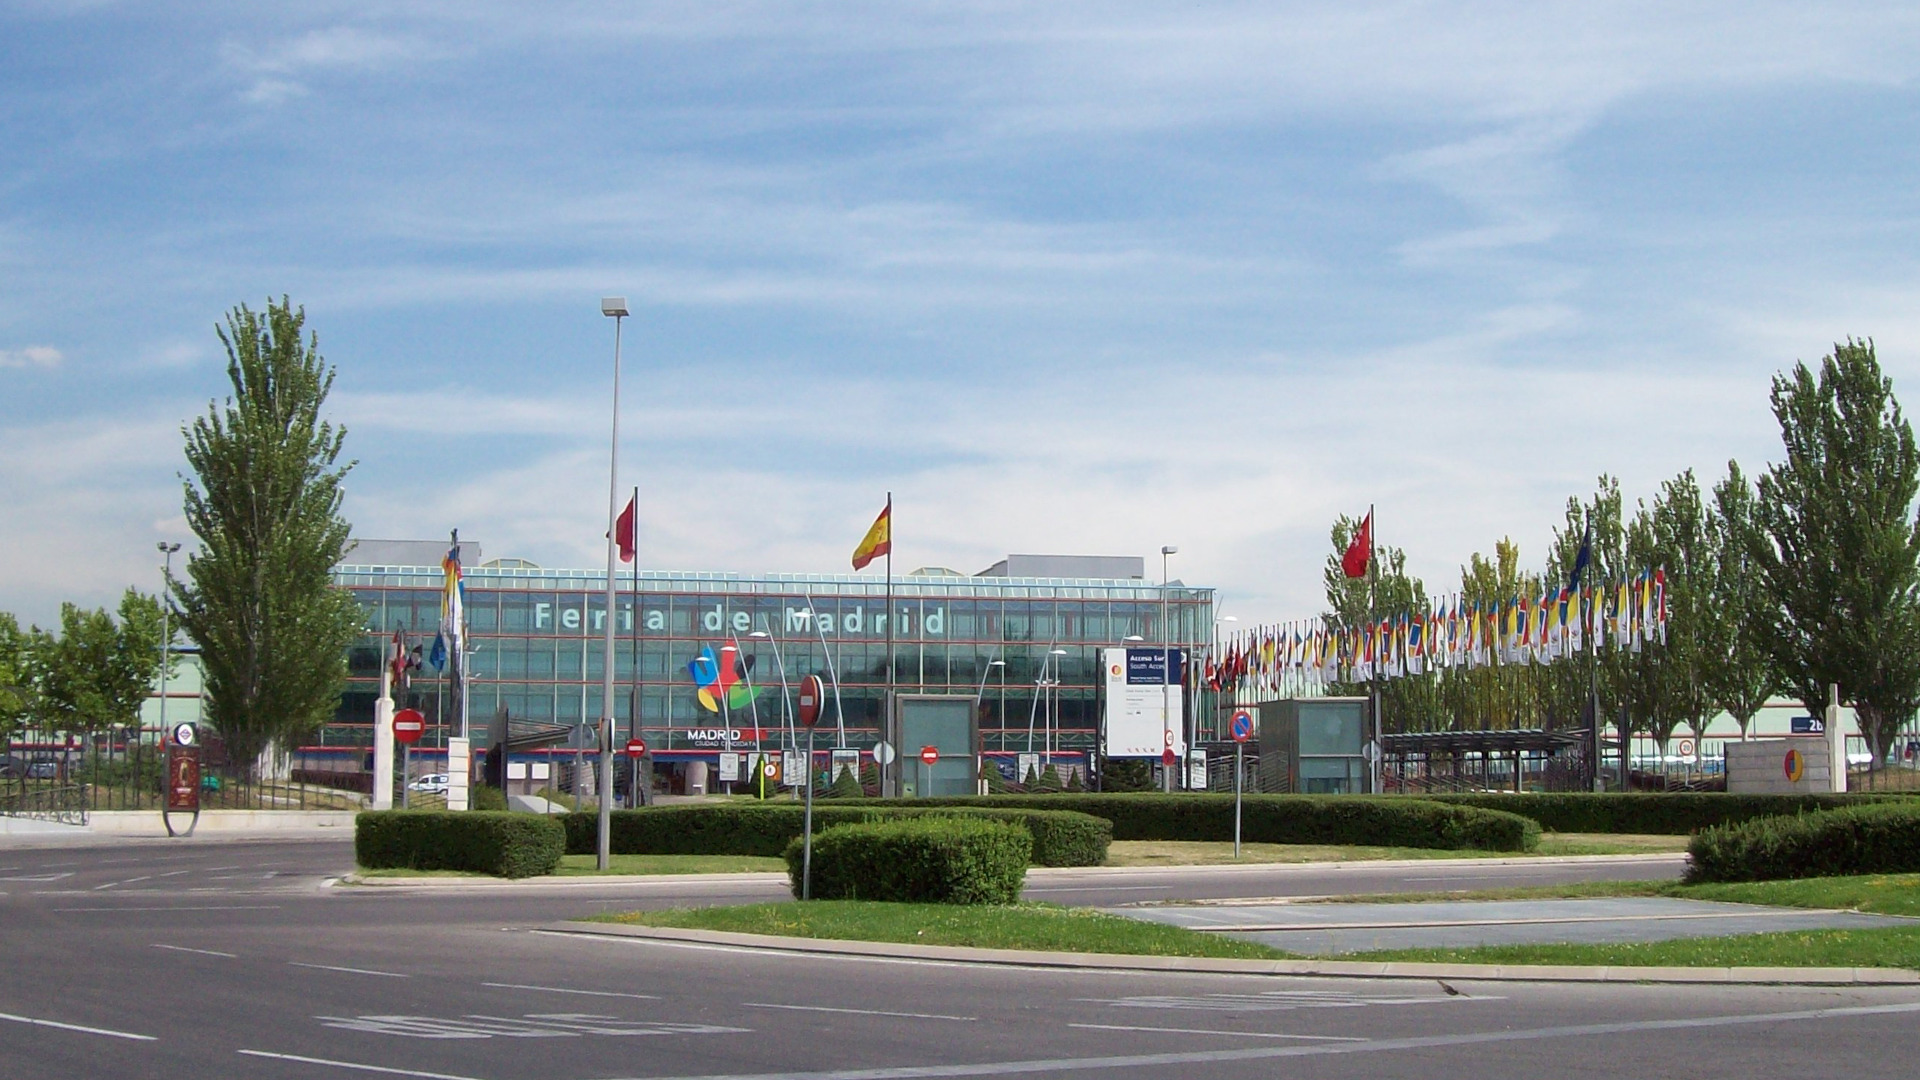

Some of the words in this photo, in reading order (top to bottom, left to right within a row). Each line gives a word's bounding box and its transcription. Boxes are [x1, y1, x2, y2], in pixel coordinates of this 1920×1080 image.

[535, 603, 664, 630] Feria
[703, 603, 751, 632] de
[785, 605, 944, 634] Madrid
[687, 729, 741, 740] MADRD
